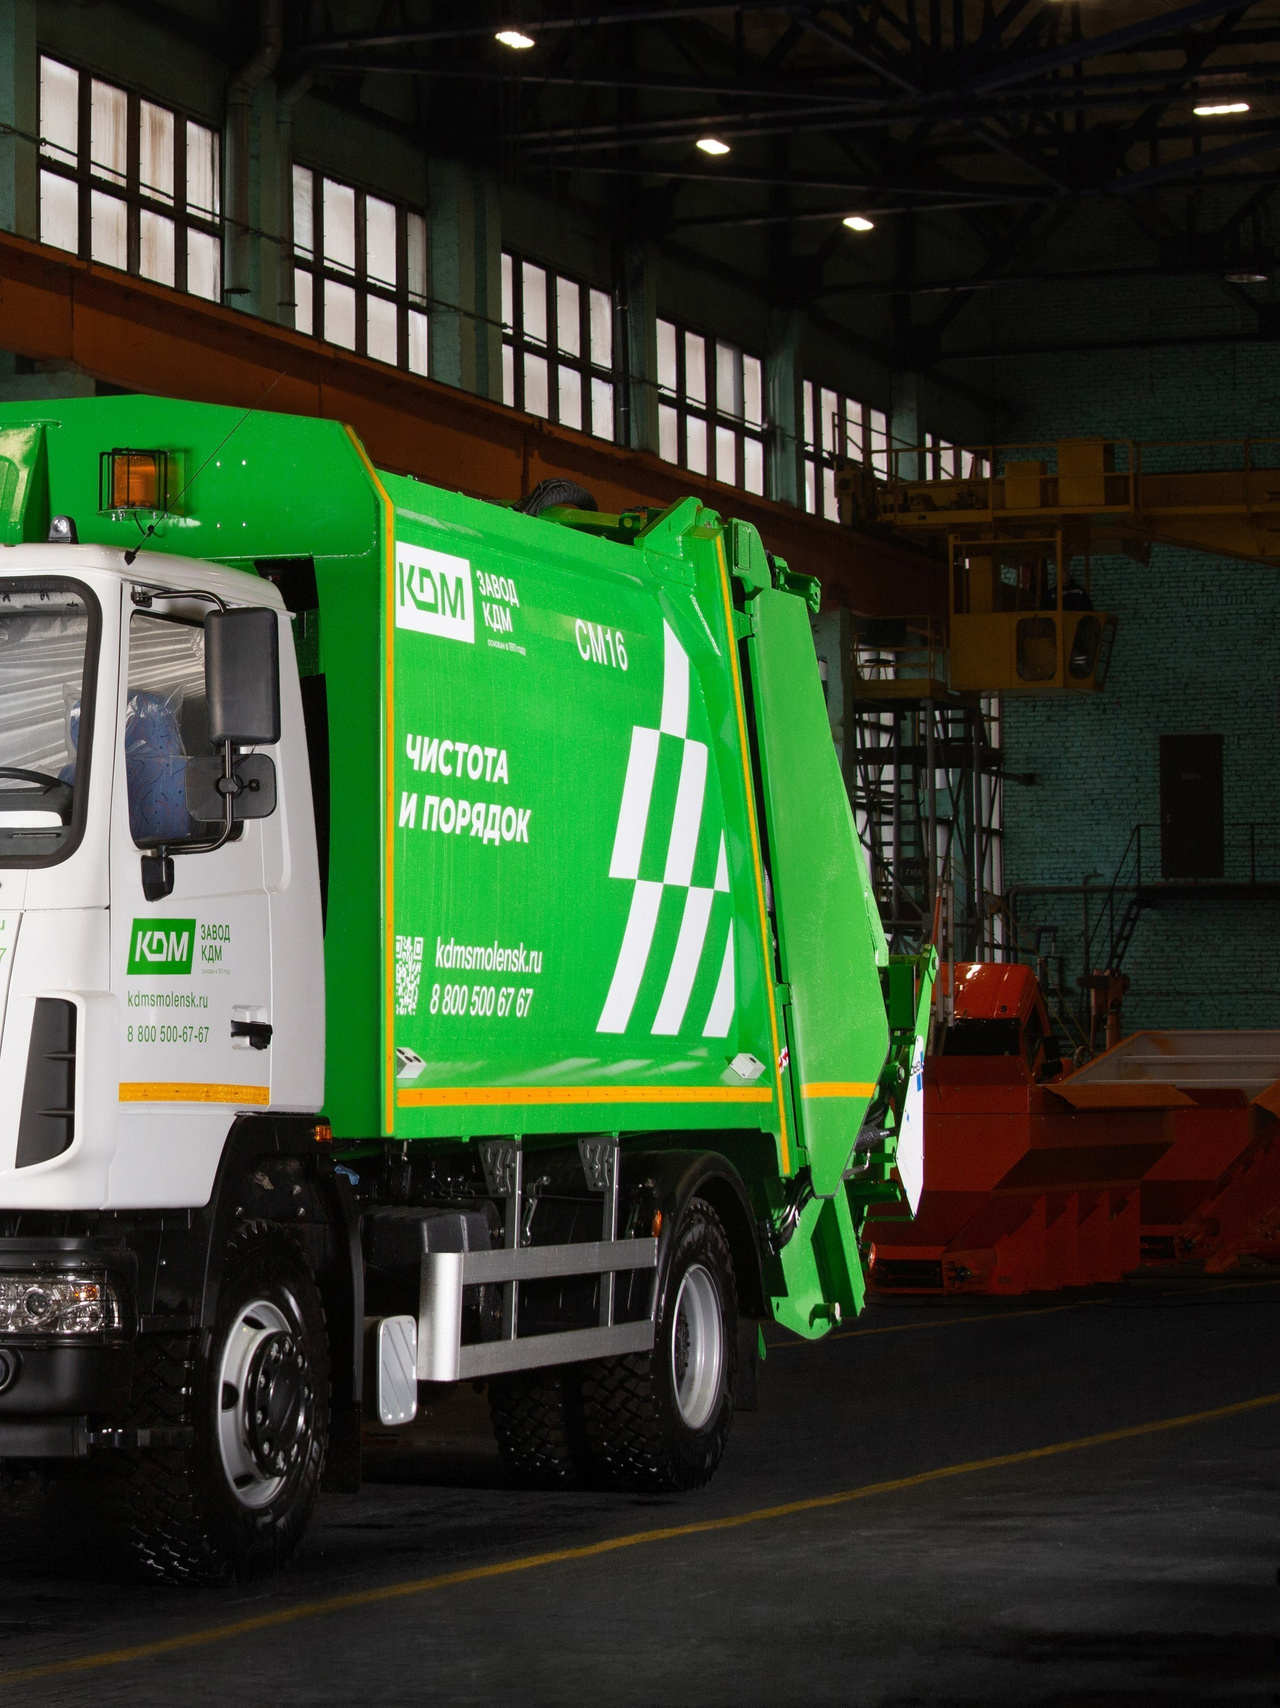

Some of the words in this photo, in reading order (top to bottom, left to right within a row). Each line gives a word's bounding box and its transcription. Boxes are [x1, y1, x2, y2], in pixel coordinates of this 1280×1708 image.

[476, 570, 520, 608] ЗАВОД
[481, 601, 513, 634] КДМ
[575, 618, 628, 671] СМ16
[405, 733, 509, 785] ЧИСТОТА
[398, 791, 418, 829] И
[421, 794, 532, 847] ПОРЯДОК
[200, 924, 231, 943] ЗАВОД
[201, 944, 223, 964] КДМ
[435, 936, 543, 974] kdmsmolensk.ru
[127, 990, 209, 1009] kdmsmolensk.ru
[429, 983, 441, 1015] 8
[441, 983, 469, 1016] 800
[469, 985, 496, 1017] 500
[497, 986, 516, 1018] 67
[515, 987, 534, 1018] 67
[127, 1025, 134, 1043] 8
[137, 1025, 157, 1043] 800
[160, 1025, 210, 1043] 500-67-67
